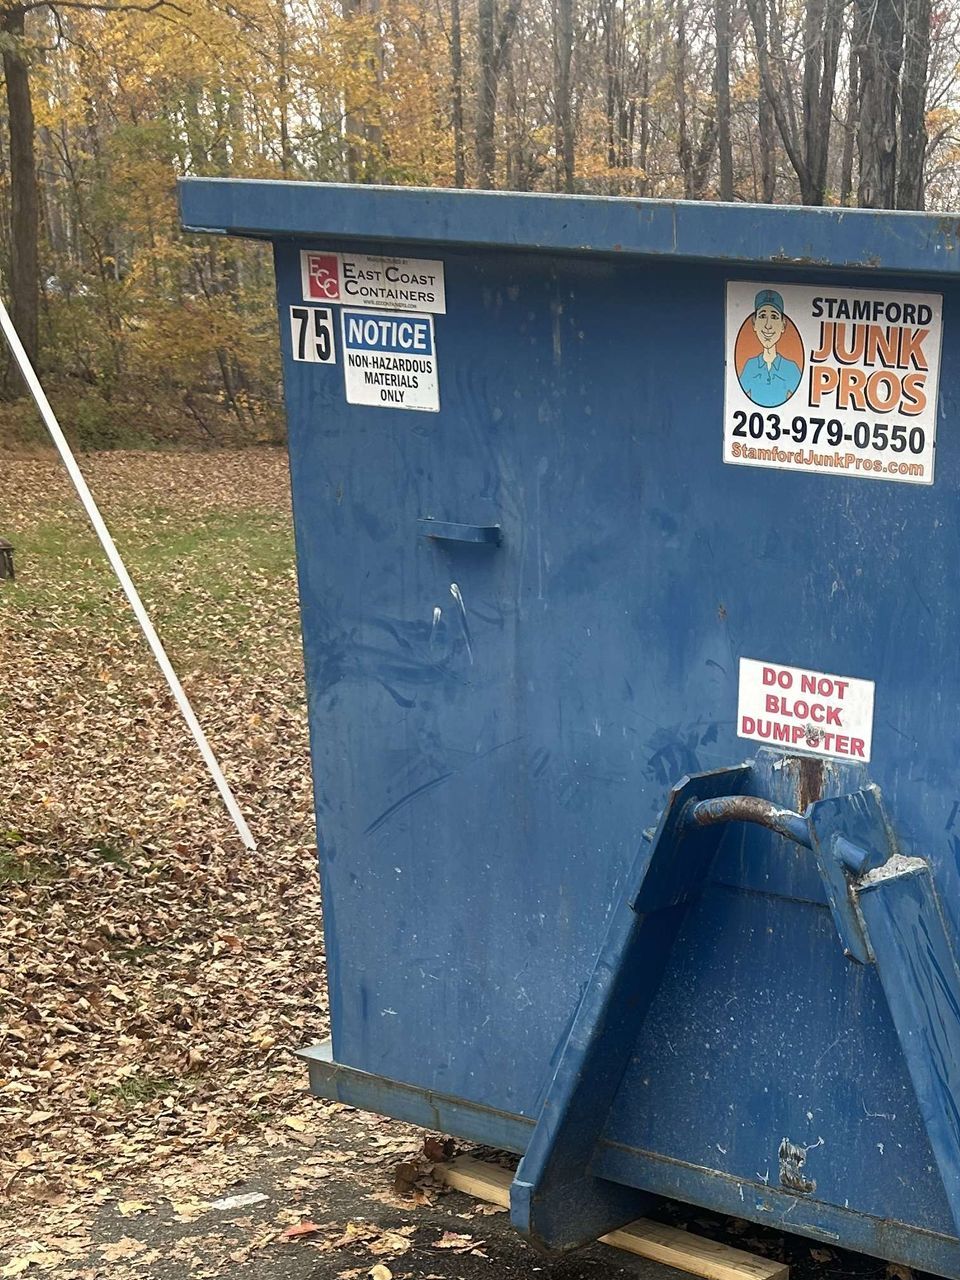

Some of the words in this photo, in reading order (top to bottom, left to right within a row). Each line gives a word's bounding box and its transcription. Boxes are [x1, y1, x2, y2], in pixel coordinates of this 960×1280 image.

[343, 263, 381, 280] EAST
[385, 267, 436, 285] COAST
[345, 280, 435, 302] CONTAINERS
[811, 297, 933, 325] STAMFORD
[292, 308, 332, 361] 75
[348, 319, 427, 349] NOTICE
[810, 321, 930, 371] JUNK
[348, 354, 433, 373] NON-HAZARDOUS
[364, 371, 419, 389] MATERIALS
[380, 389, 405, 403] ONLY
[808, 365, 928, 416] PROS
[732, 411, 925, 454] 203-979-0550
[731, 442, 925, 476] StamfordJunkPros.com
[762, 666, 794, 690] DO
[800, 674, 850, 700] NOT
[765, 693, 844, 727] BLOCK
